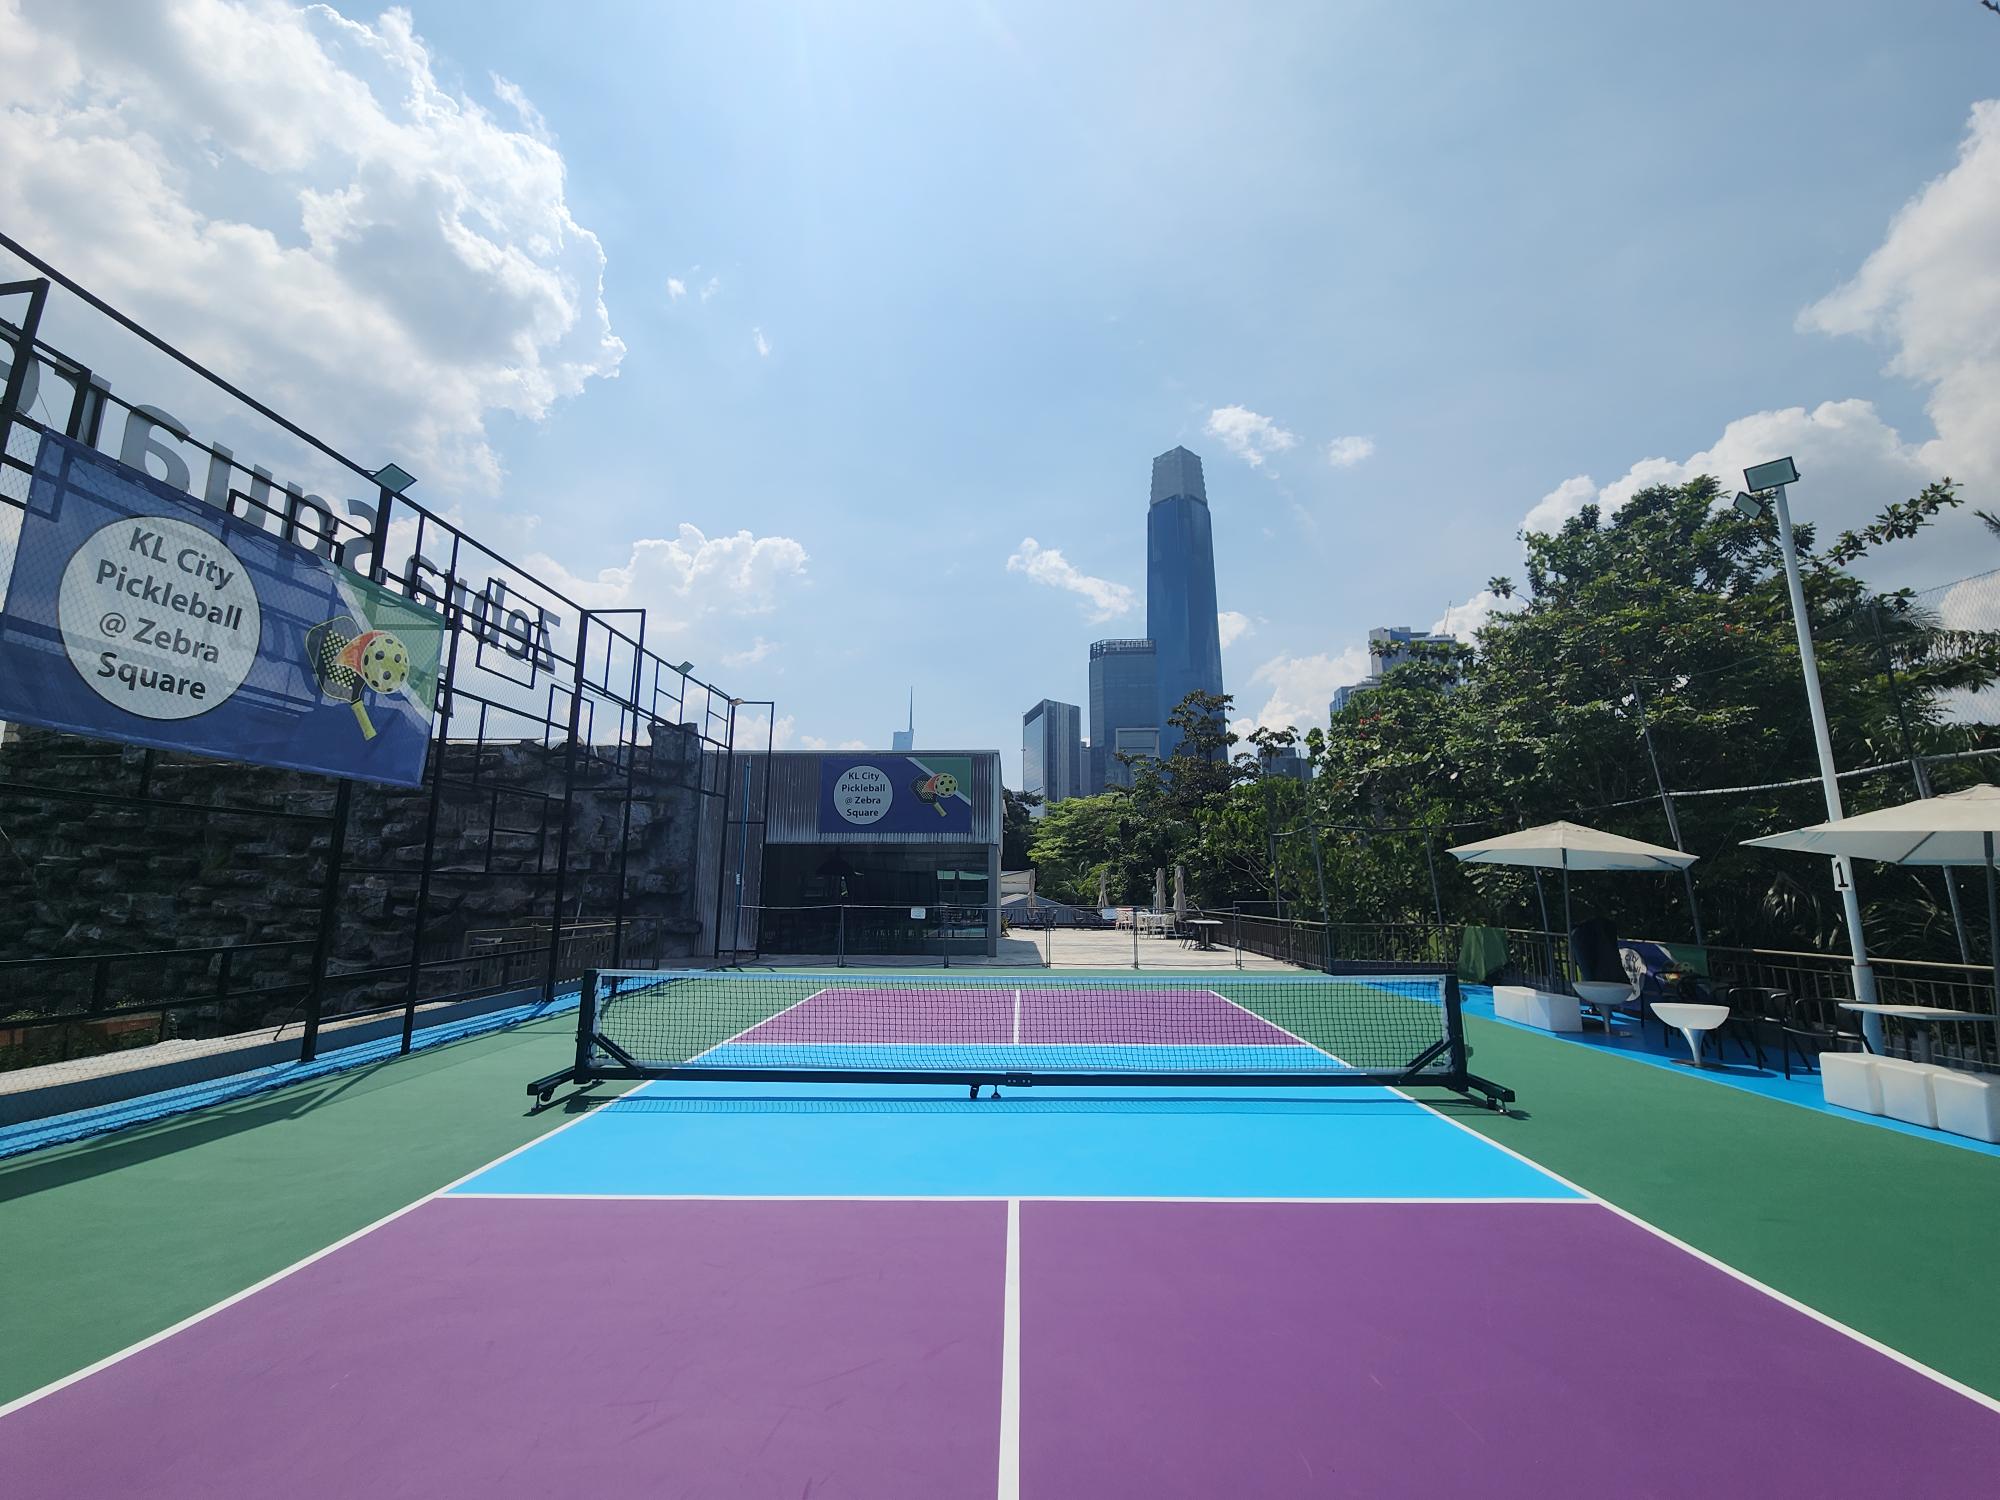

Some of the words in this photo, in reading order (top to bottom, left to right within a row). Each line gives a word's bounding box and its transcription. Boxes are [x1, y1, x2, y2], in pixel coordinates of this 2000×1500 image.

[129, 526, 167, 564] KL
[177, 548, 235, 591] City
[96, 558, 243, 631] Pickleball
[99, 611, 127, 638] @
[132, 617, 220, 664] Zebra
[96, 651, 206, 700] Square
[841, 784, 886, 792] Pickleball
[861, 772, 880, 781] City
[845, 797, 853, 805] @
[854, 796, 881, 804] Zebra
[846, 808, 879, 818] Square
[1835, 862, 1849, 887] 1
